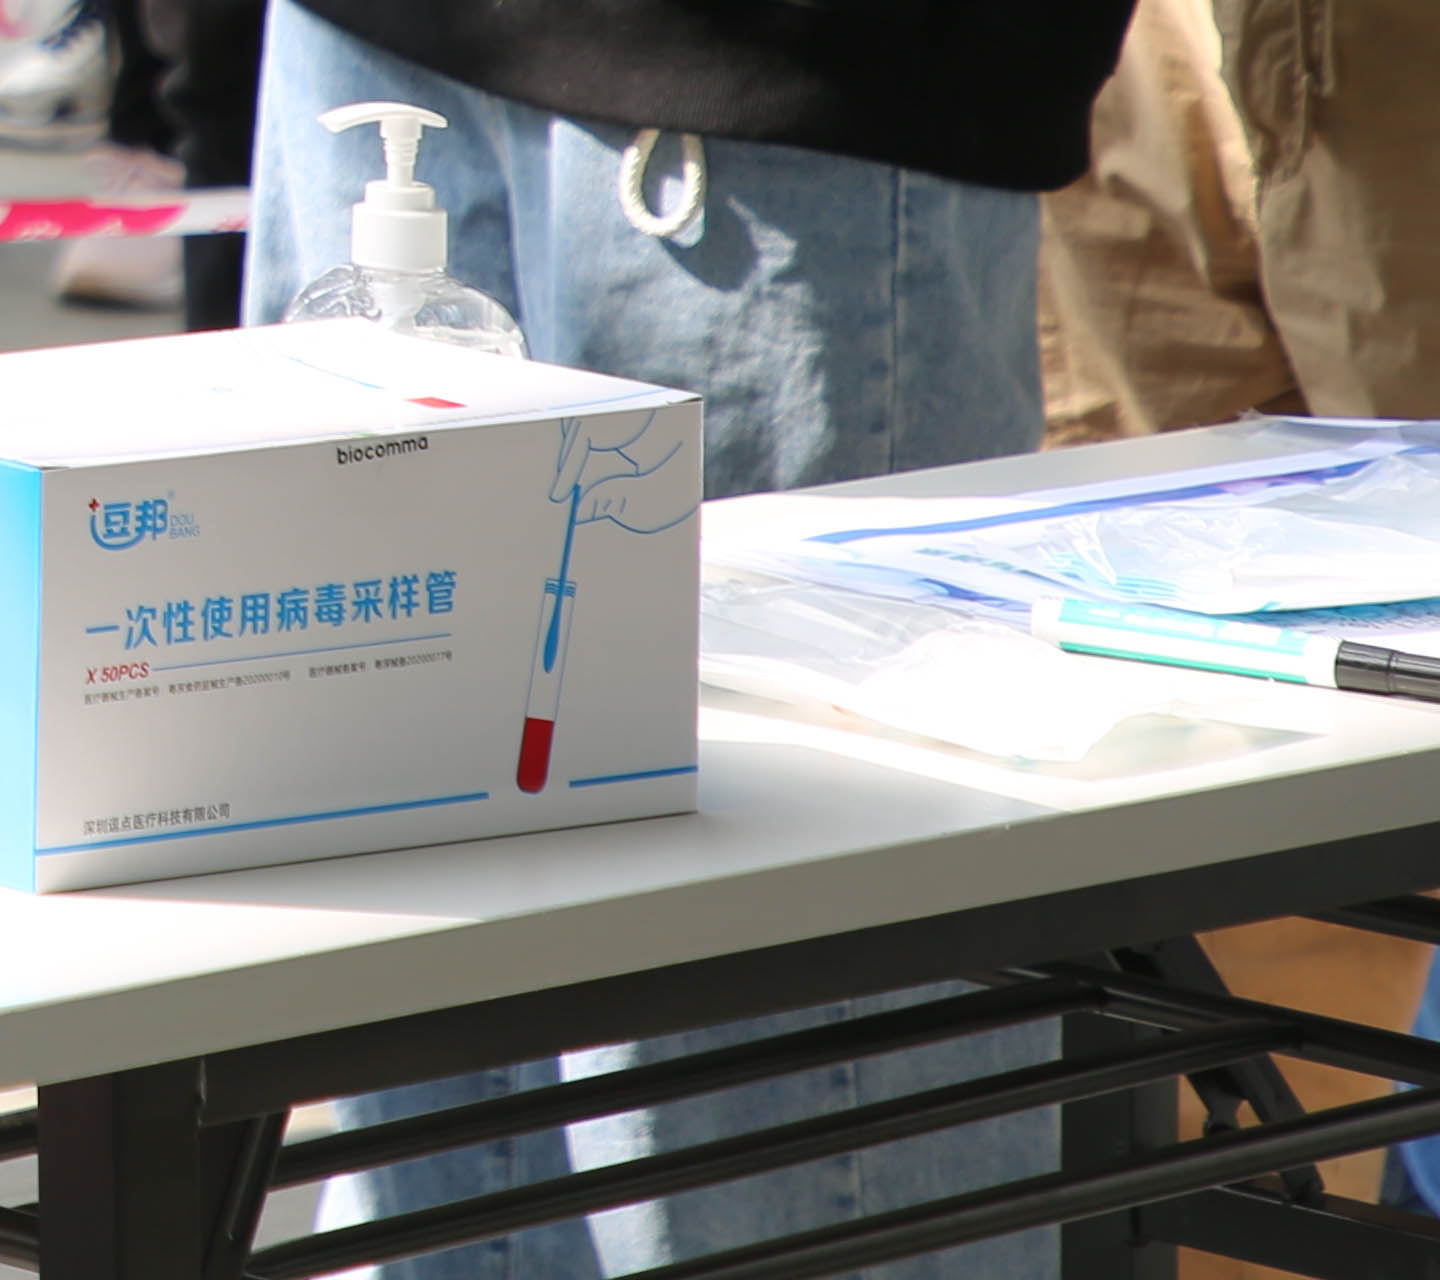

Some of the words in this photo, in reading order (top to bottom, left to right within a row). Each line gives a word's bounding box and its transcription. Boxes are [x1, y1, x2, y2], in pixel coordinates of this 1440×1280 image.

[336, 436, 429, 465] biocomma
[84, 570, 458, 650] 一次性使用病毒采样管
[101, 662, 150, 684] 50PCS
